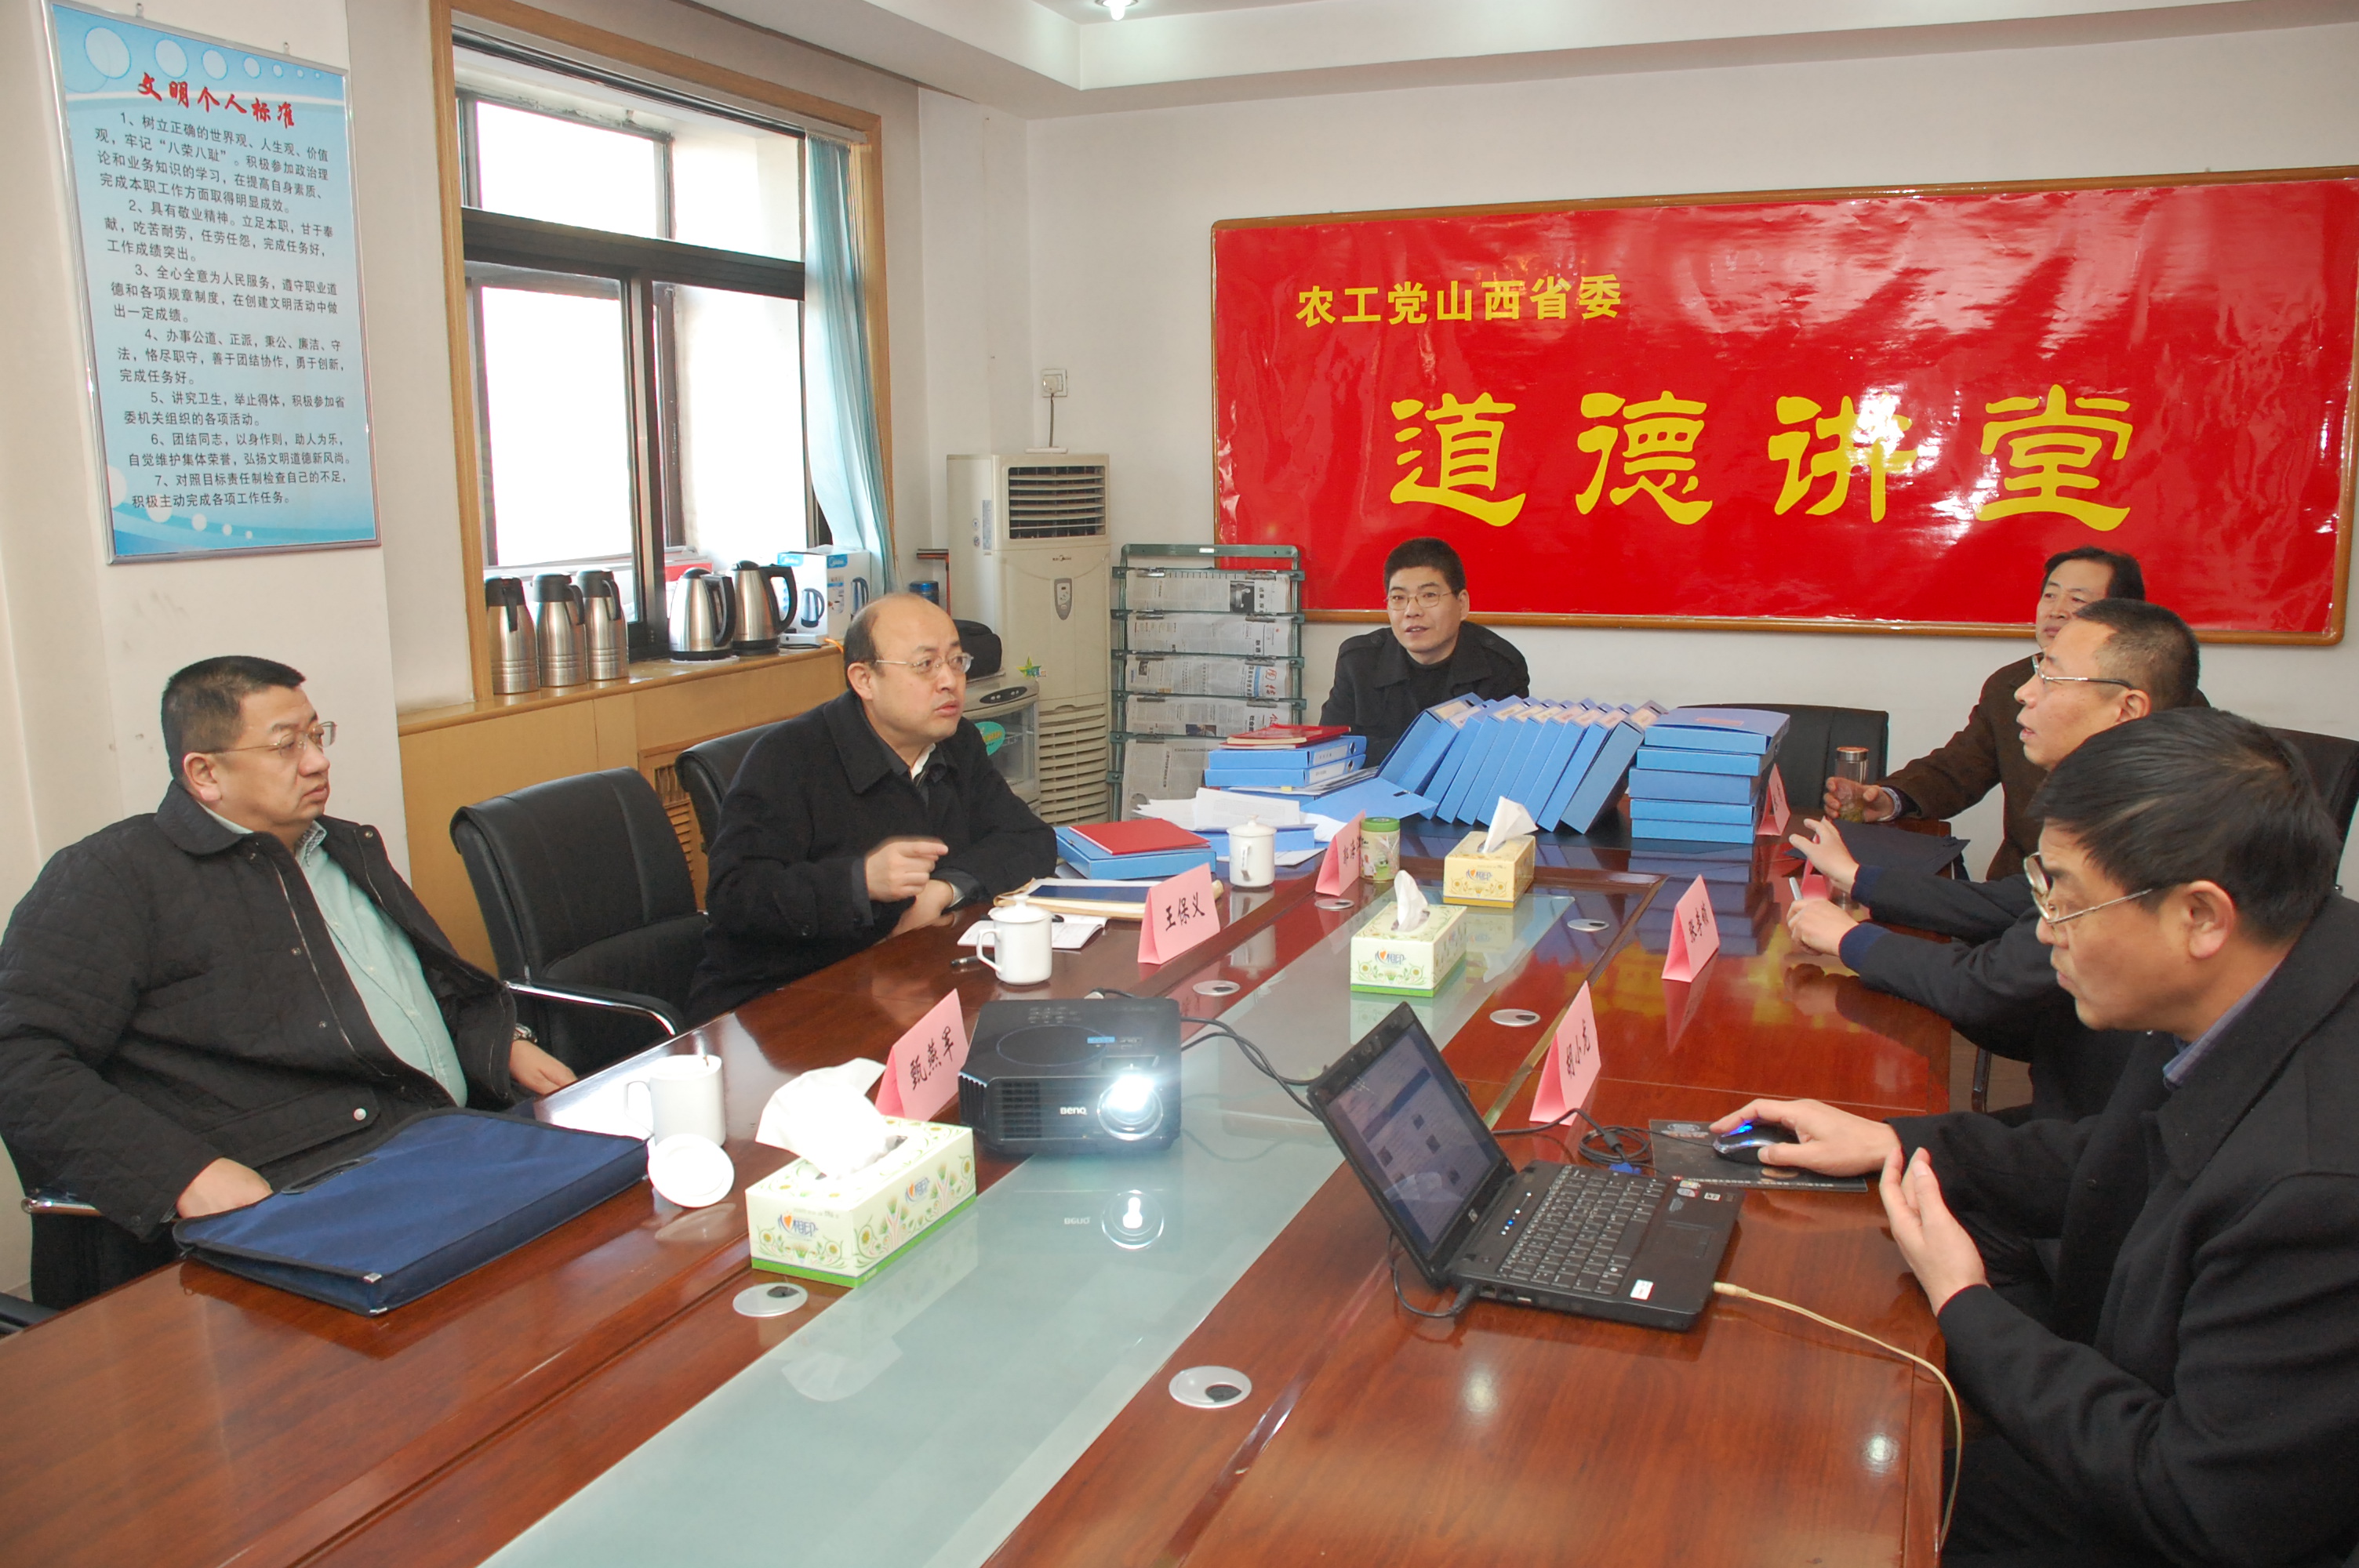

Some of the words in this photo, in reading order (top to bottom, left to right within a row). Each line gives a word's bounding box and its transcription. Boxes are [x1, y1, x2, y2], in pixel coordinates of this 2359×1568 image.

[137, 72, 295, 129] 文明个人标准
[120, 111, 329, 162] 1、树立正确的世界观、人生观、价值
[97, 150, 323, 199] 论和业务知识的学习，在提高自身素质、
[100, 172, 289, 214] 完成本职工作方面取得明显成效。
[129, 200, 333, 238] 2、具有敬业精神。立足本职，甘于奉
[104, 216, 326, 257] 献，吃苦耐劳，任劳任怨，完成任务好，
[107, 239, 197, 262] 工作成绩突出。
[135, 264, 337, 296] 3、全心全意为人民服务，遵守职业道
[111, 281, 338, 314] 德和各项规章制度，在创建文明活动中做
[1296, 273, 1623, 328] 农工党山西省委
[114, 303, 189, 323] 出一定成绩。
[120, 368, 194, 385] 完成任务好。
[151, 391, 345, 409] 5、讲究卫生，举止得体，积极参加省
[124, 411, 260, 426] 委机关组织的各项活动。
[151, 432, 343, 447] 6、团结同志，以身作则，助人为乐，
[129, 452, 350, 467] 自觉维护集体荣誉，弘扬文明道德新风尚。
[1388, 383, 2134, 532] 道德讲堂
[154, 470, 346, 488] 7、对照目标责任制检查自己的不足，
[132, 492, 289, 509] 积极主动完成各项工作任务。
[1060, 1106, 1088, 1116] BenQ
